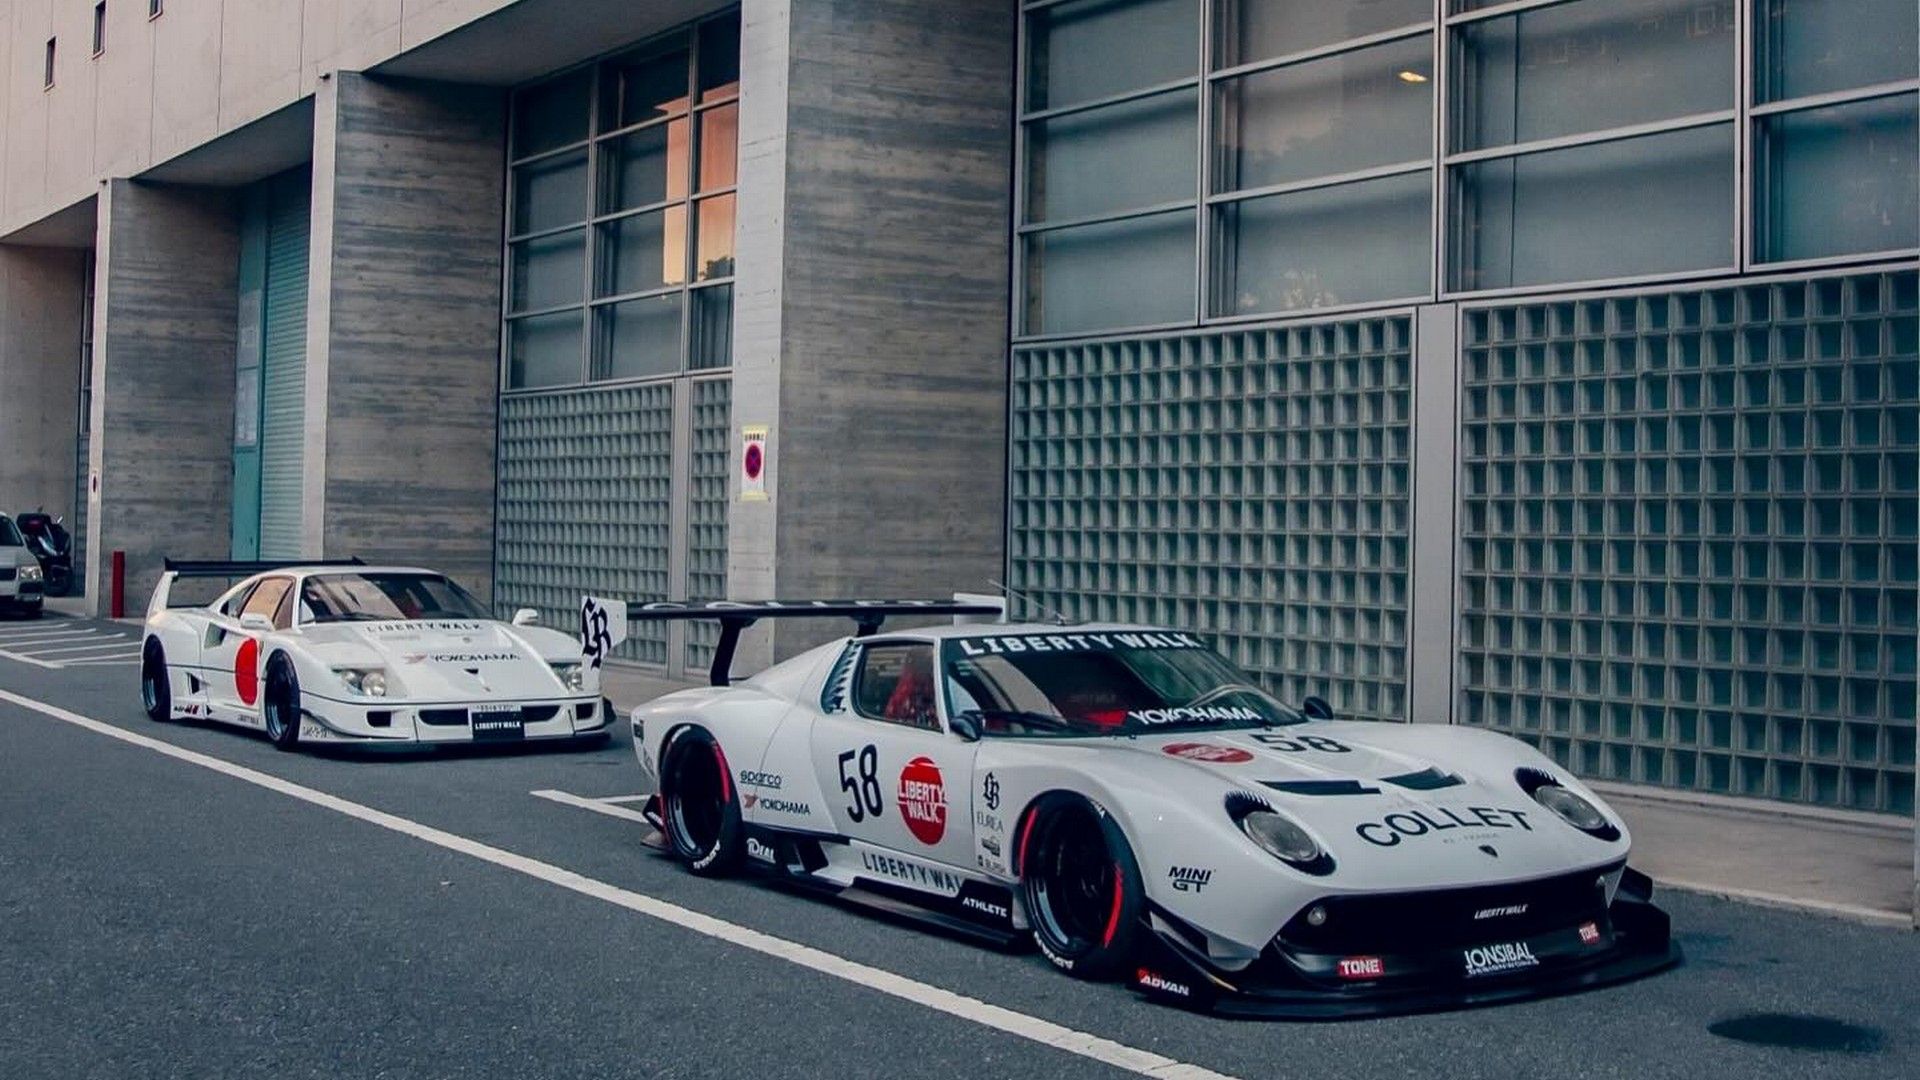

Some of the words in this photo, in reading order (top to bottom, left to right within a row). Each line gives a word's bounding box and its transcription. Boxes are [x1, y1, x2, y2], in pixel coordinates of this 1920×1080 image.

[366, 623, 435, 633] LIBERTY
[438, 622, 483, 631] WALK
[960, 634, 1115, 655] LIBERTY
[1114, 633, 1202, 649] WALK
[430, 652, 520, 662] YOKOHAMA
[1128, 705, 1263, 725] YOKOHAMA
[475, 721, 502, 730] LIBERTY
[503, 720, 521, 729] WALK
[1248, 734, 1352, 753] 58
[740, 770, 782, 788] sparco
[838, 744, 883, 823] 58
[897, 779, 945, 804] LIBERTY
[760, 798, 811, 816] YOKOHAMA
[907, 801, 939, 823] WALK
[1356, 807, 1533, 846] COLLET
[862, 852, 928, 885] LIBERTY
[1168, 866, 1212, 881] MINI
[1172, 880, 1207, 893] GT
[962, 897, 1008, 918] ATHLETE
[1474, 907, 1505, 919] LIBERTY
[1505, 904, 1528, 915] WALK
[1579, 922, 1599, 941] TONE
[1464, 942, 1534, 970] JONSIBAL
[1340, 958, 1380, 975] TONE
[1140, 976, 1190, 996] ADVAN
